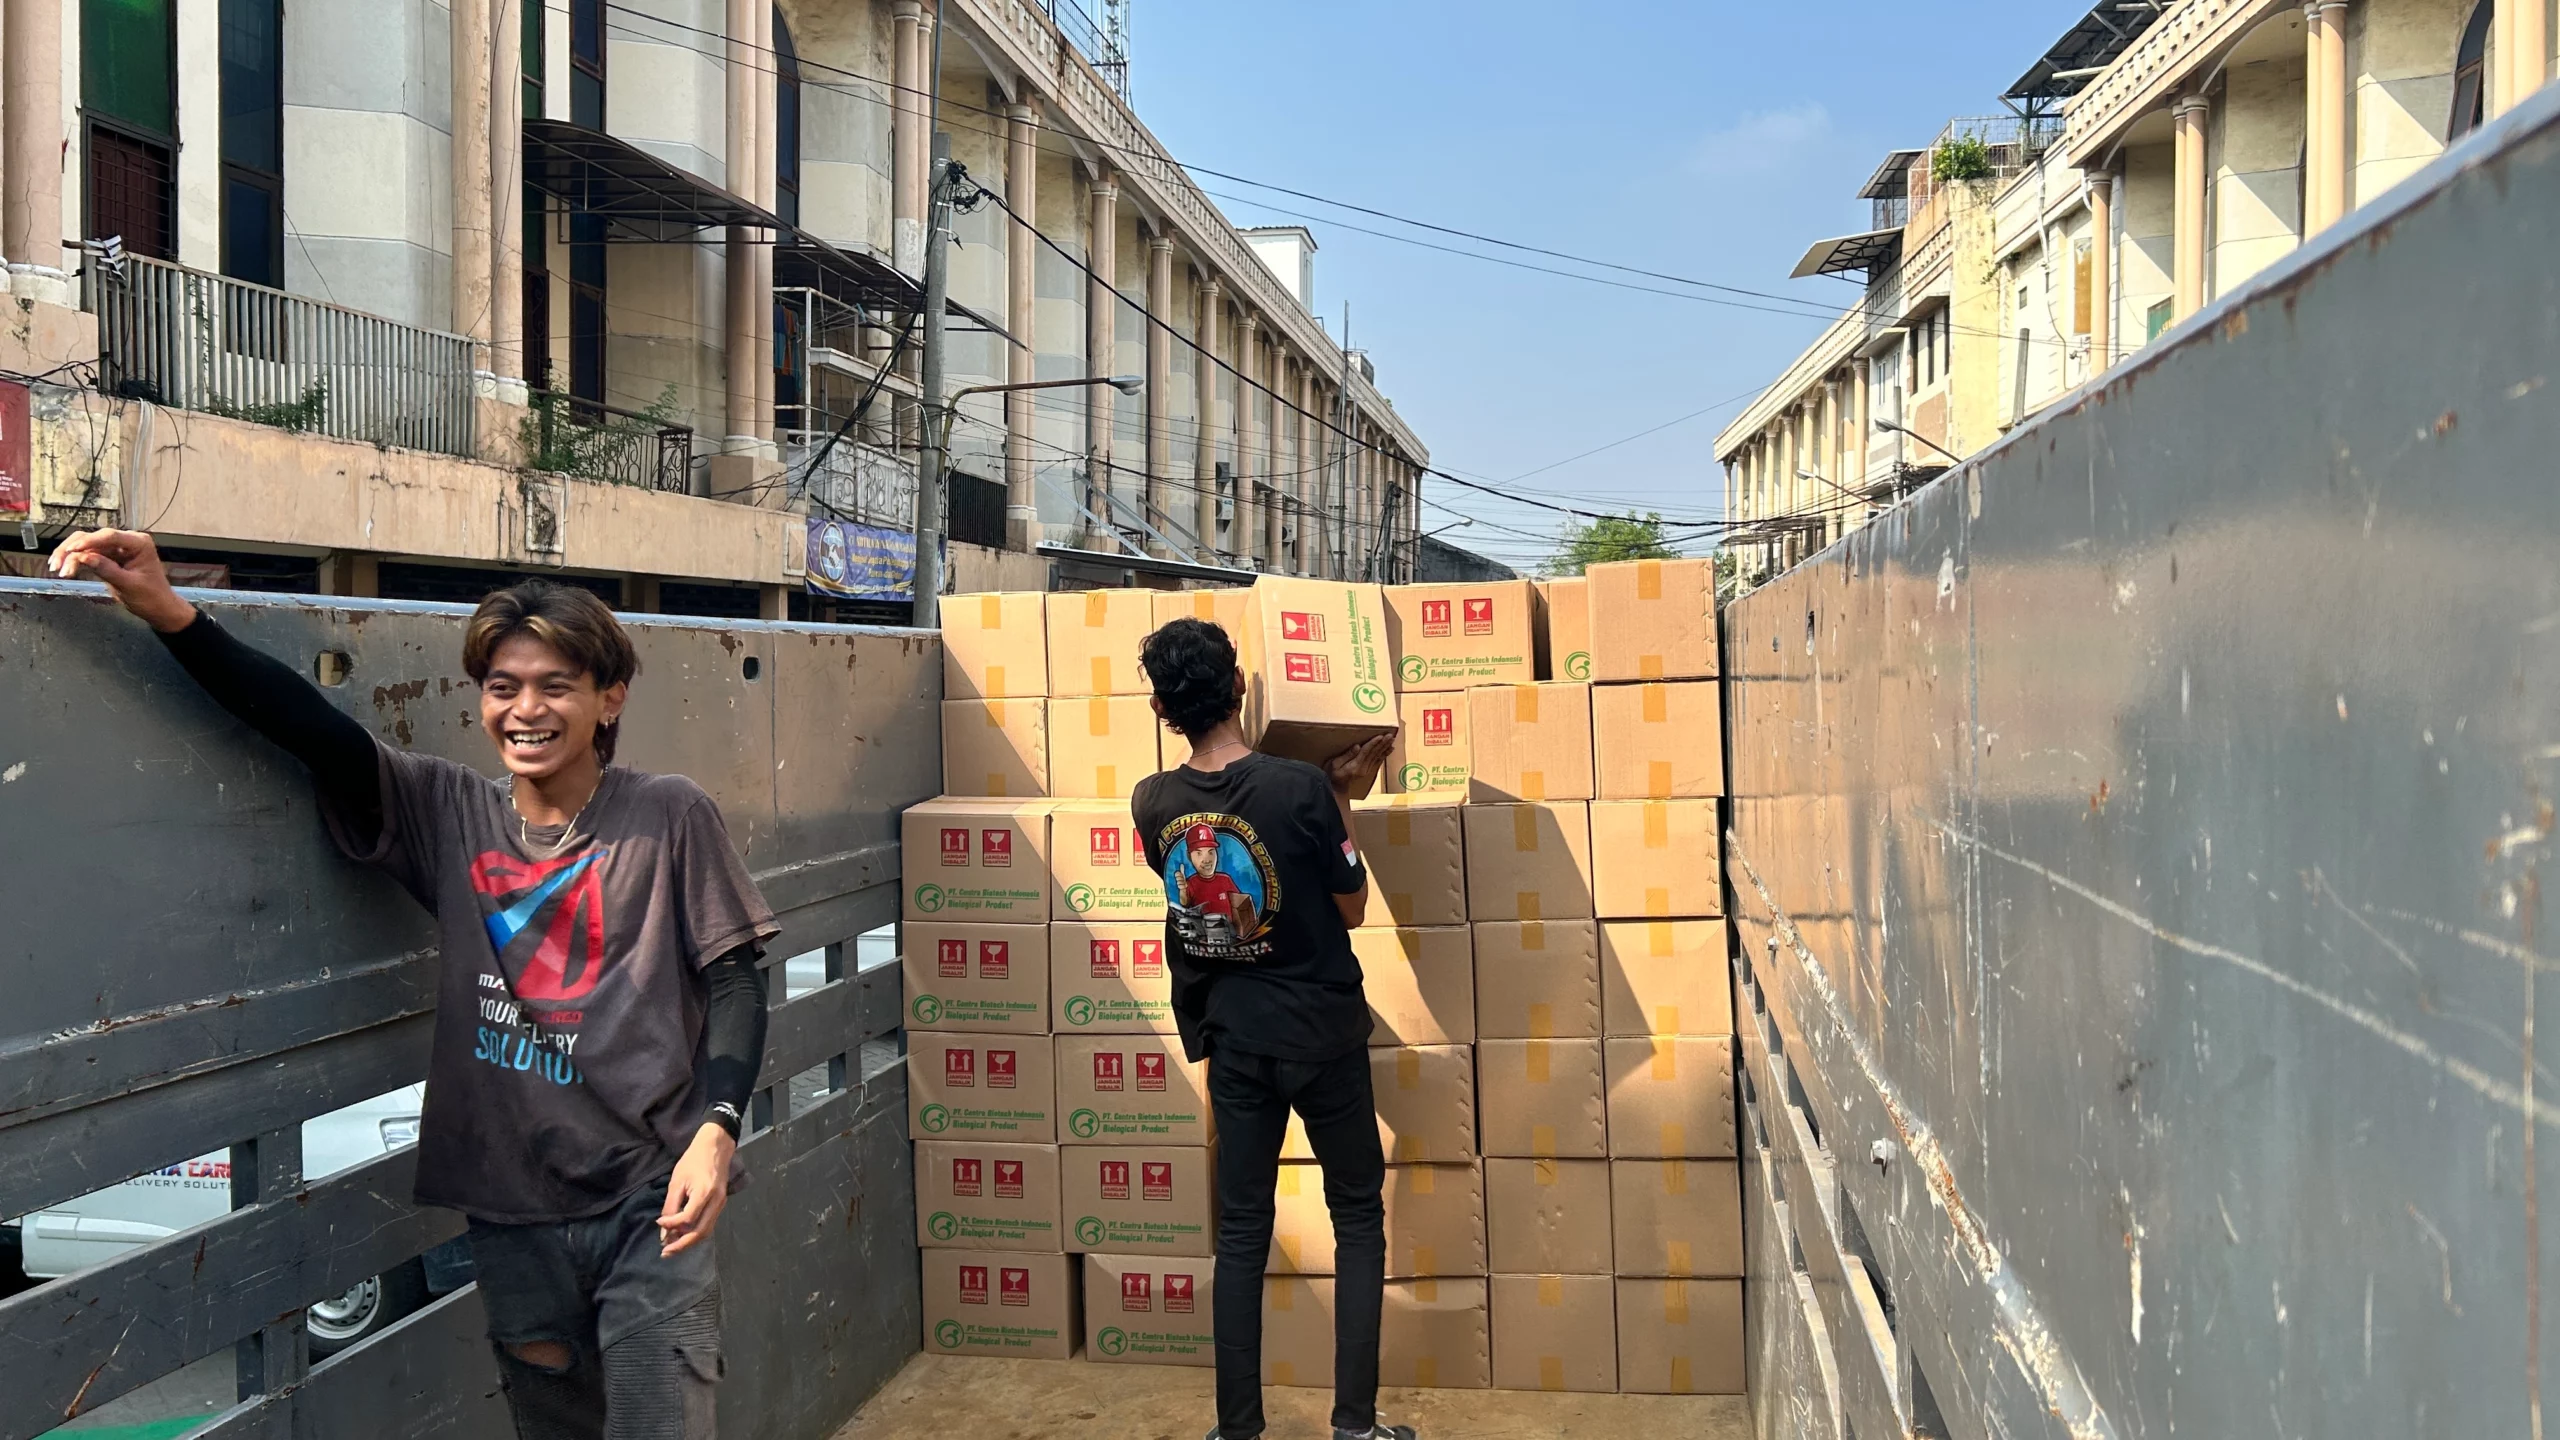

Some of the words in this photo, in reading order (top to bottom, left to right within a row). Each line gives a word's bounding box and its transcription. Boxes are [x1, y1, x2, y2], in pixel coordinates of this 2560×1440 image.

[1347, 590, 1356, 619] Indonesia
[1349, 621, 1360, 645] Biotech
[1362, 616, 1372, 643] Product
[1365, 647, 1377, 680] Biological
[1491, 655, 1523, 663] Indonesia
[1431, 668, 1464, 678] Biological
[1468, 668, 1496, 676] Product
[1432, 777, 1465, 786] Biological
[982, 889, 1007, 897] Biotech
[948, 900, 982, 910] Biological
[985, 901, 1013, 909] Product
[1098, 899, 1133, 908] Biological
[1137, 900, 1164, 908] Product
[1134, 1000, 1158, 1008] Biotech
[479, 996, 518, 1027] YOUR
[945, 1011, 979, 1021] Biological
[983, 1012, 1010, 1021] Product
[1098, 1012, 1133, 1021] Biological
[1137, 1012, 1164, 1020] Product
[987, 1109, 1012, 1117] Biotech
[1013, 1110, 1044, 1118] Indonesia
[953, 1120, 986, 1130] Biological
[991, 1121, 1018, 1130] Product
[1103, 1124, 1137, 1134] Biological
[1141, 1125, 1169, 1133] Product
[188, 1162, 230, 1178] CAR
[125, 1178, 178, 1187] ELIVERY
[183, 1180, 231, 1190] SOLUTI
[996, 1218, 1019, 1226] Biotech
[1021, 1220, 1052, 1228] Indonesia
[1143, 1222, 1168, 1230] Biotech
[1170, 1223, 1202, 1231] Indonesia
[961, 1228, 994, 1238] Biological
[998, 1230, 1025, 1239] Product
[1108, 1233, 1143, 1243] Biological
[1147, 1234, 1174, 1243] Product
[1001, 1326, 1025, 1334] Biotech
[1027, 1327, 1058, 1336] Indonesia
[967, 1336, 1000, 1346] Biological
[1004, 1338, 1032, 1347] Product
[1166, 1333, 1190, 1341] Biotech
[1131, 1343, 1165, 1353] Biological
[1169, 1345, 1197, 1354] Product
